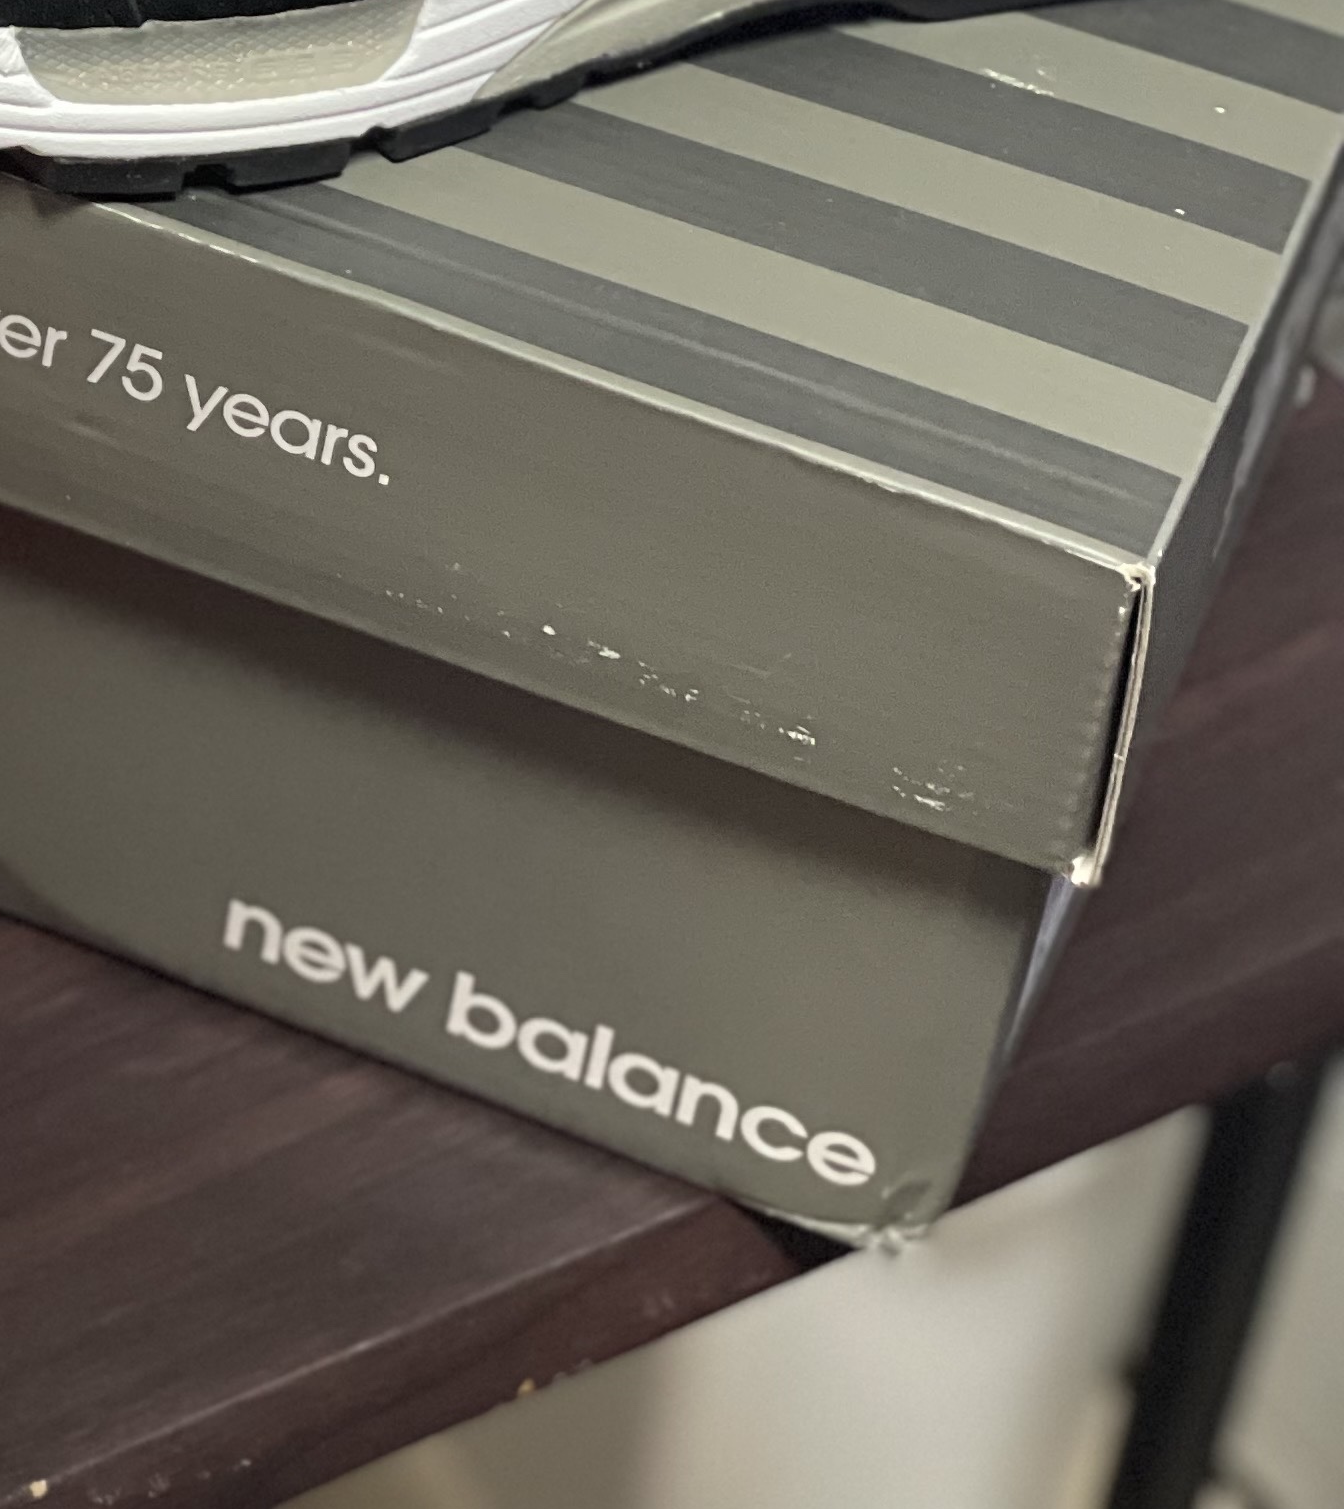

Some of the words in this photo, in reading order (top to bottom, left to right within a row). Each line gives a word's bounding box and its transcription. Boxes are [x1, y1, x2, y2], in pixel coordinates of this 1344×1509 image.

[85, 327, 165, 402] 75
[183, 370, 395, 485] years.
[221, 897, 430, 1013] new
[444, 969, 879, 1186] balance
